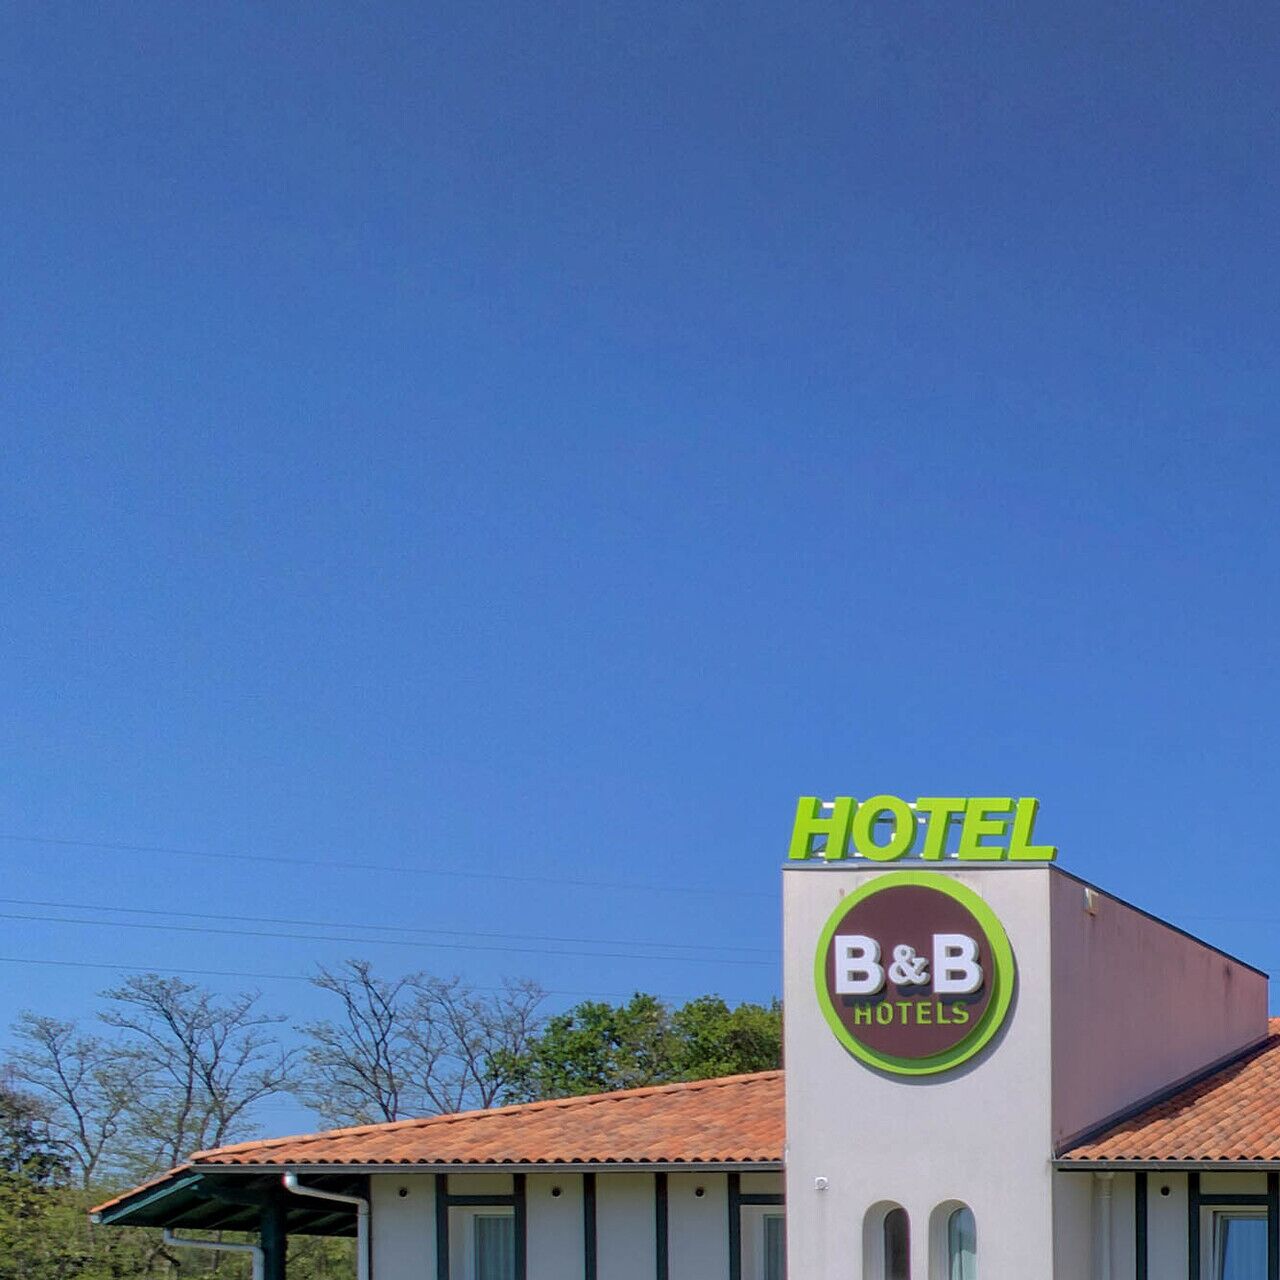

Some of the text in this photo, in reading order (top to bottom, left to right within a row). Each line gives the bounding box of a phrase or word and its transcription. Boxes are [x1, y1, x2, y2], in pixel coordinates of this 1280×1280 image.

[788, 795, 1058, 862] HOTEL
[834, 934, 984, 996] B&B
[854, 1001, 970, 1025] HOTELS
